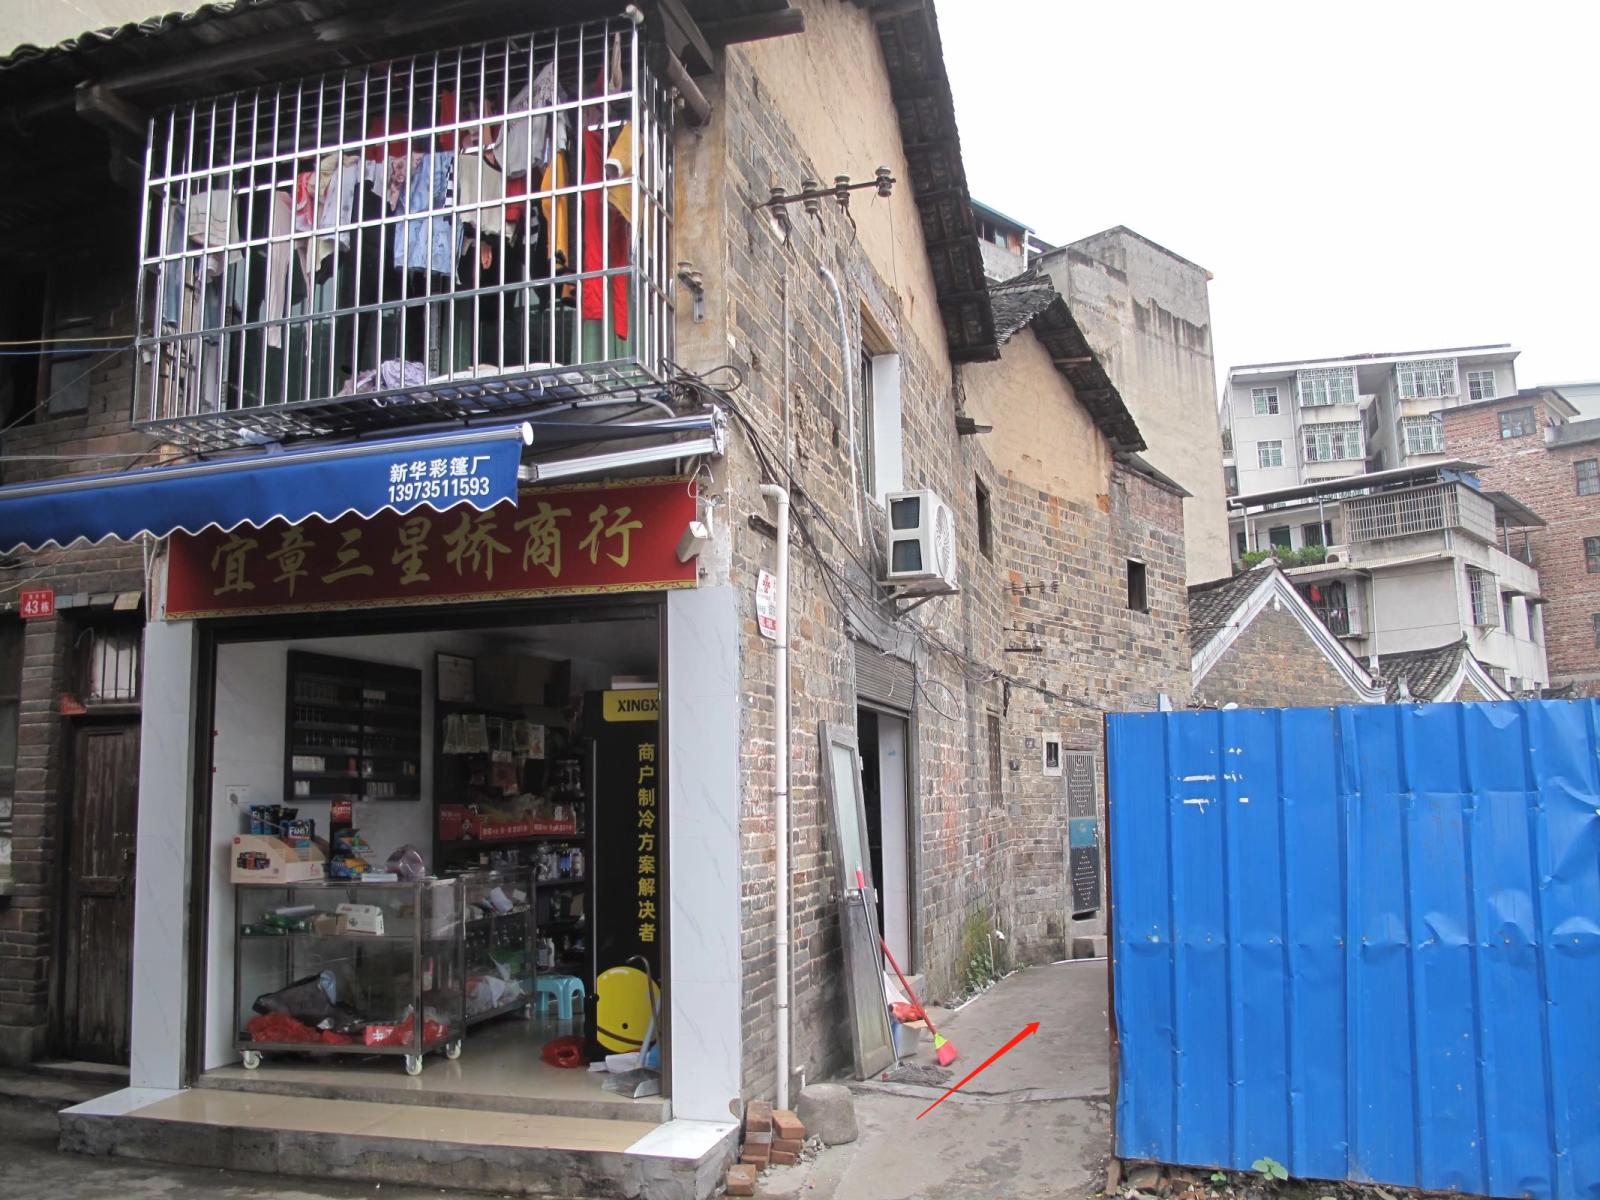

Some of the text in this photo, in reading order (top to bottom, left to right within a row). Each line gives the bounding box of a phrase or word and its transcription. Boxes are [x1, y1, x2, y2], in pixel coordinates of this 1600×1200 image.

[388, 477, 490, 503] 13973511593
[390, 456, 491, 483] 新华彩篷厂
[210, 502, 643, 598] 宜章三星桥商行
[637, 742, 656, 942] 商户制冷方案解决者
